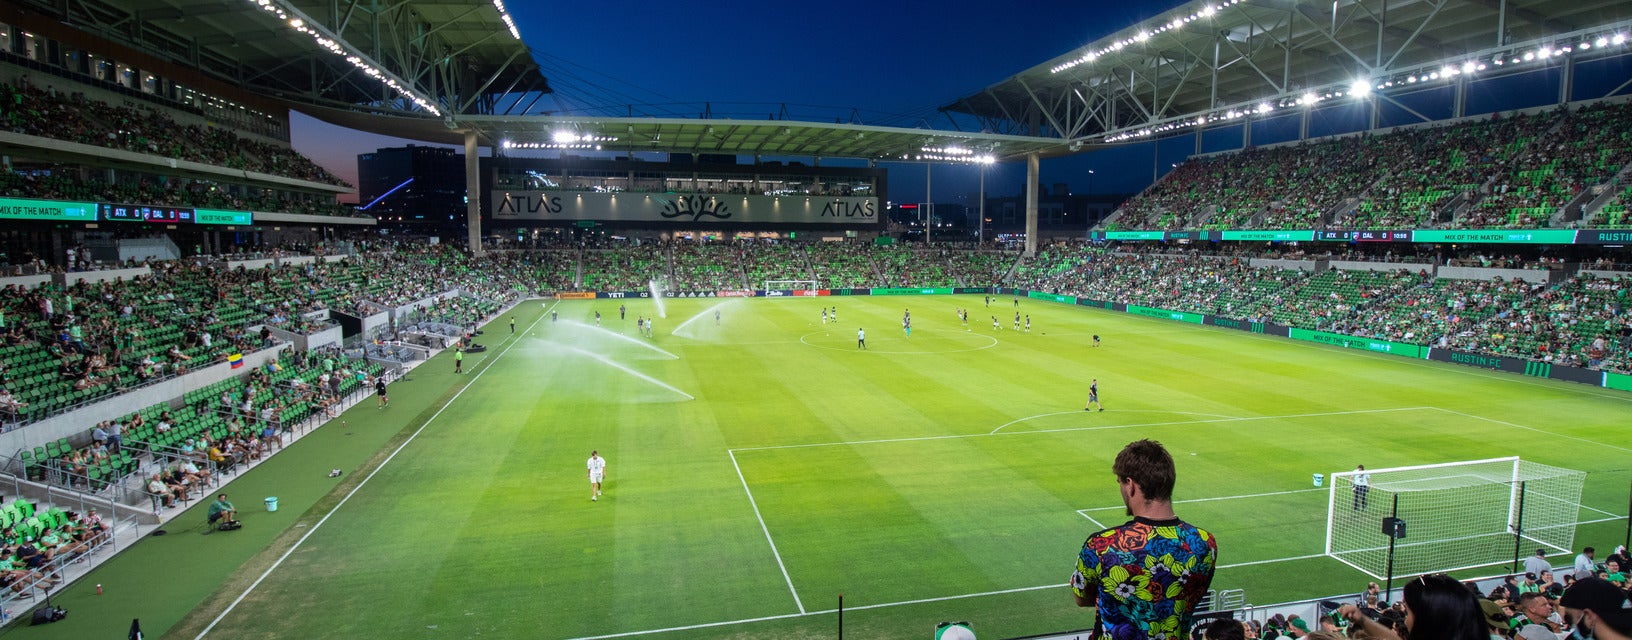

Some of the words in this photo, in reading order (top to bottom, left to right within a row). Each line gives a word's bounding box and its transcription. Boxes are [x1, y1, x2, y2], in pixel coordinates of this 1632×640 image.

[498, 196, 562, 213] ATLAS
[821, 201, 874, 217] ATLAS
[13, 206, 22, 215] OF
[24, 207, 37, 216] THE
[39, 207, 61, 216] MATCH
[115, 208, 127, 217] ATX
[153, 210, 163, 218] DAL
[1333, 337, 1344, 345] THE
[1452, 352, 1487, 366] AUSTIN
[1490, 358, 1501, 368] FC
